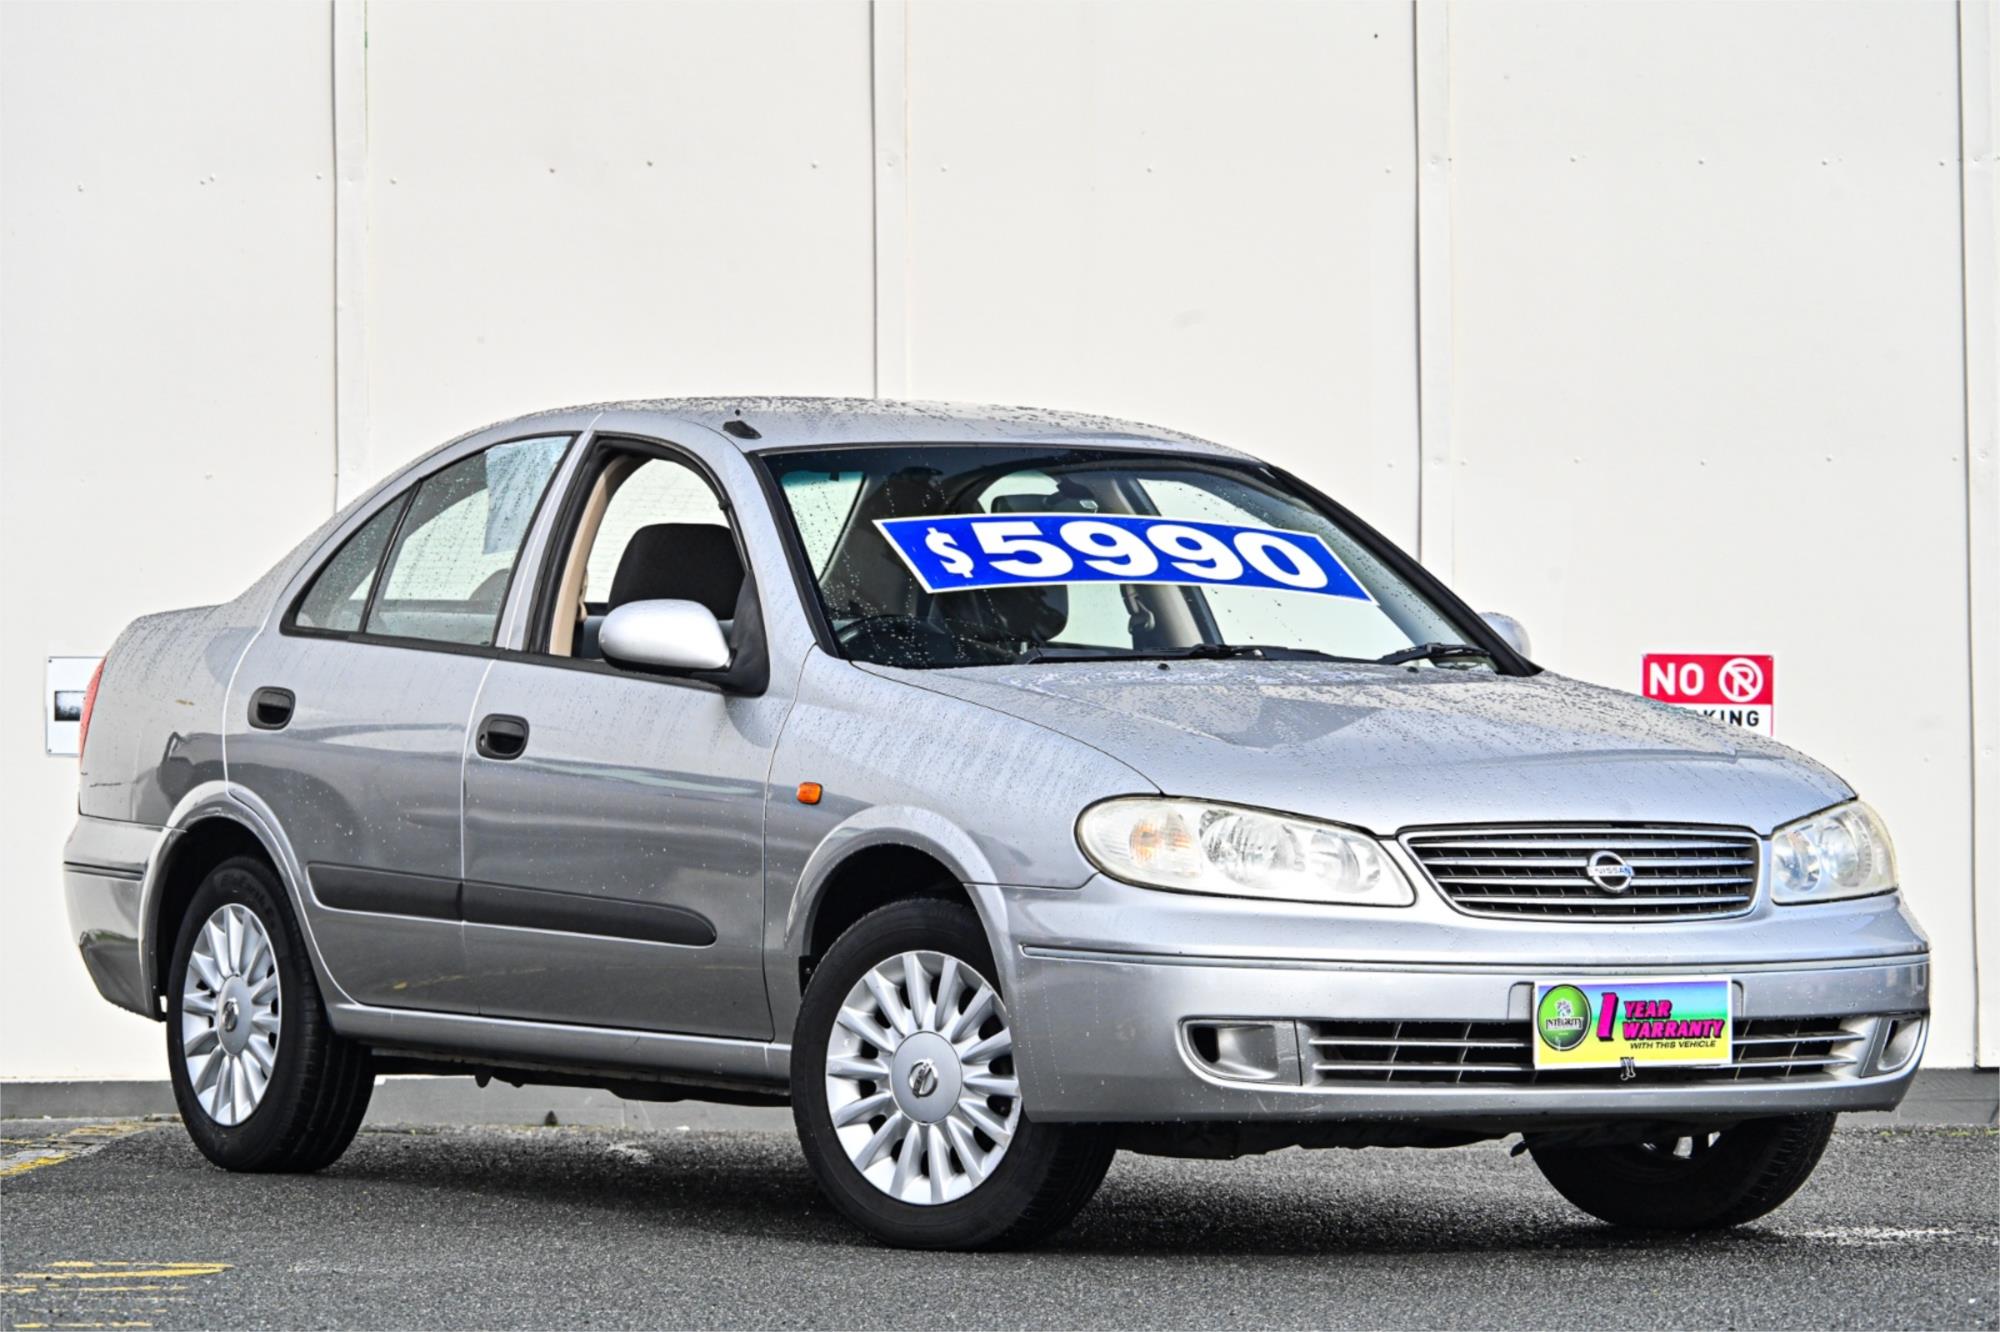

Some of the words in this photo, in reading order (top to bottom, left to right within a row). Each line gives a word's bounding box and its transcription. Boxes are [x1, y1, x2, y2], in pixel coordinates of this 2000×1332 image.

[925, 521, 1328, 589] $5990
[1650, 662, 1704, 696] NO
[1596, 992, 1619, 1041] 1
[1623, 1000, 1673, 1020] YEAR
[1622, 1019, 1725, 1040] WARRANTY
[1630, 1042, 1653, 1050] WITH
[1656, 1041, 1676, 1049] THIS
[1678, 1040, 1716, 1048] VEHICLE
